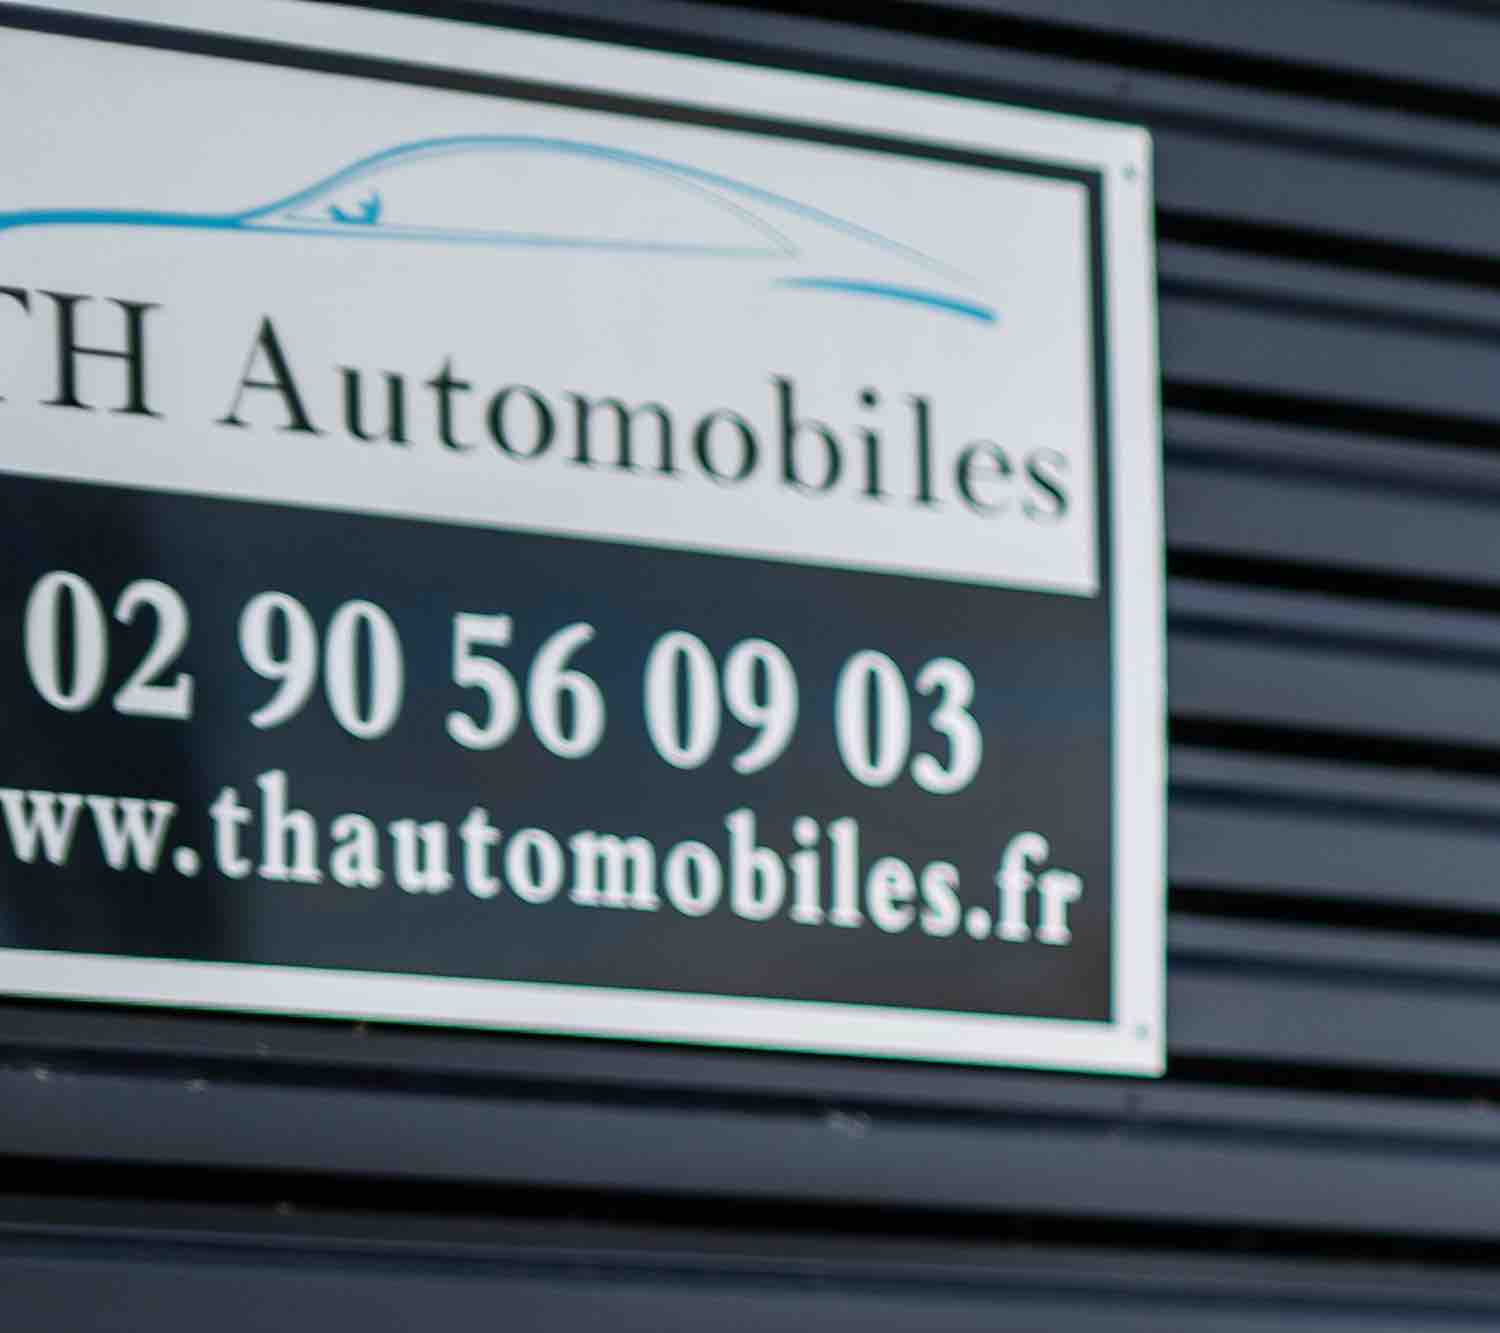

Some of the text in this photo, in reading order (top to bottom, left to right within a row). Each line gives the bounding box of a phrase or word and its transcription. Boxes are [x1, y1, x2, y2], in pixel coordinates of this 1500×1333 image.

[216, 314, 1073, 523] Automobiles
[25, 570, 986, 794] 02 90 56 09 03
